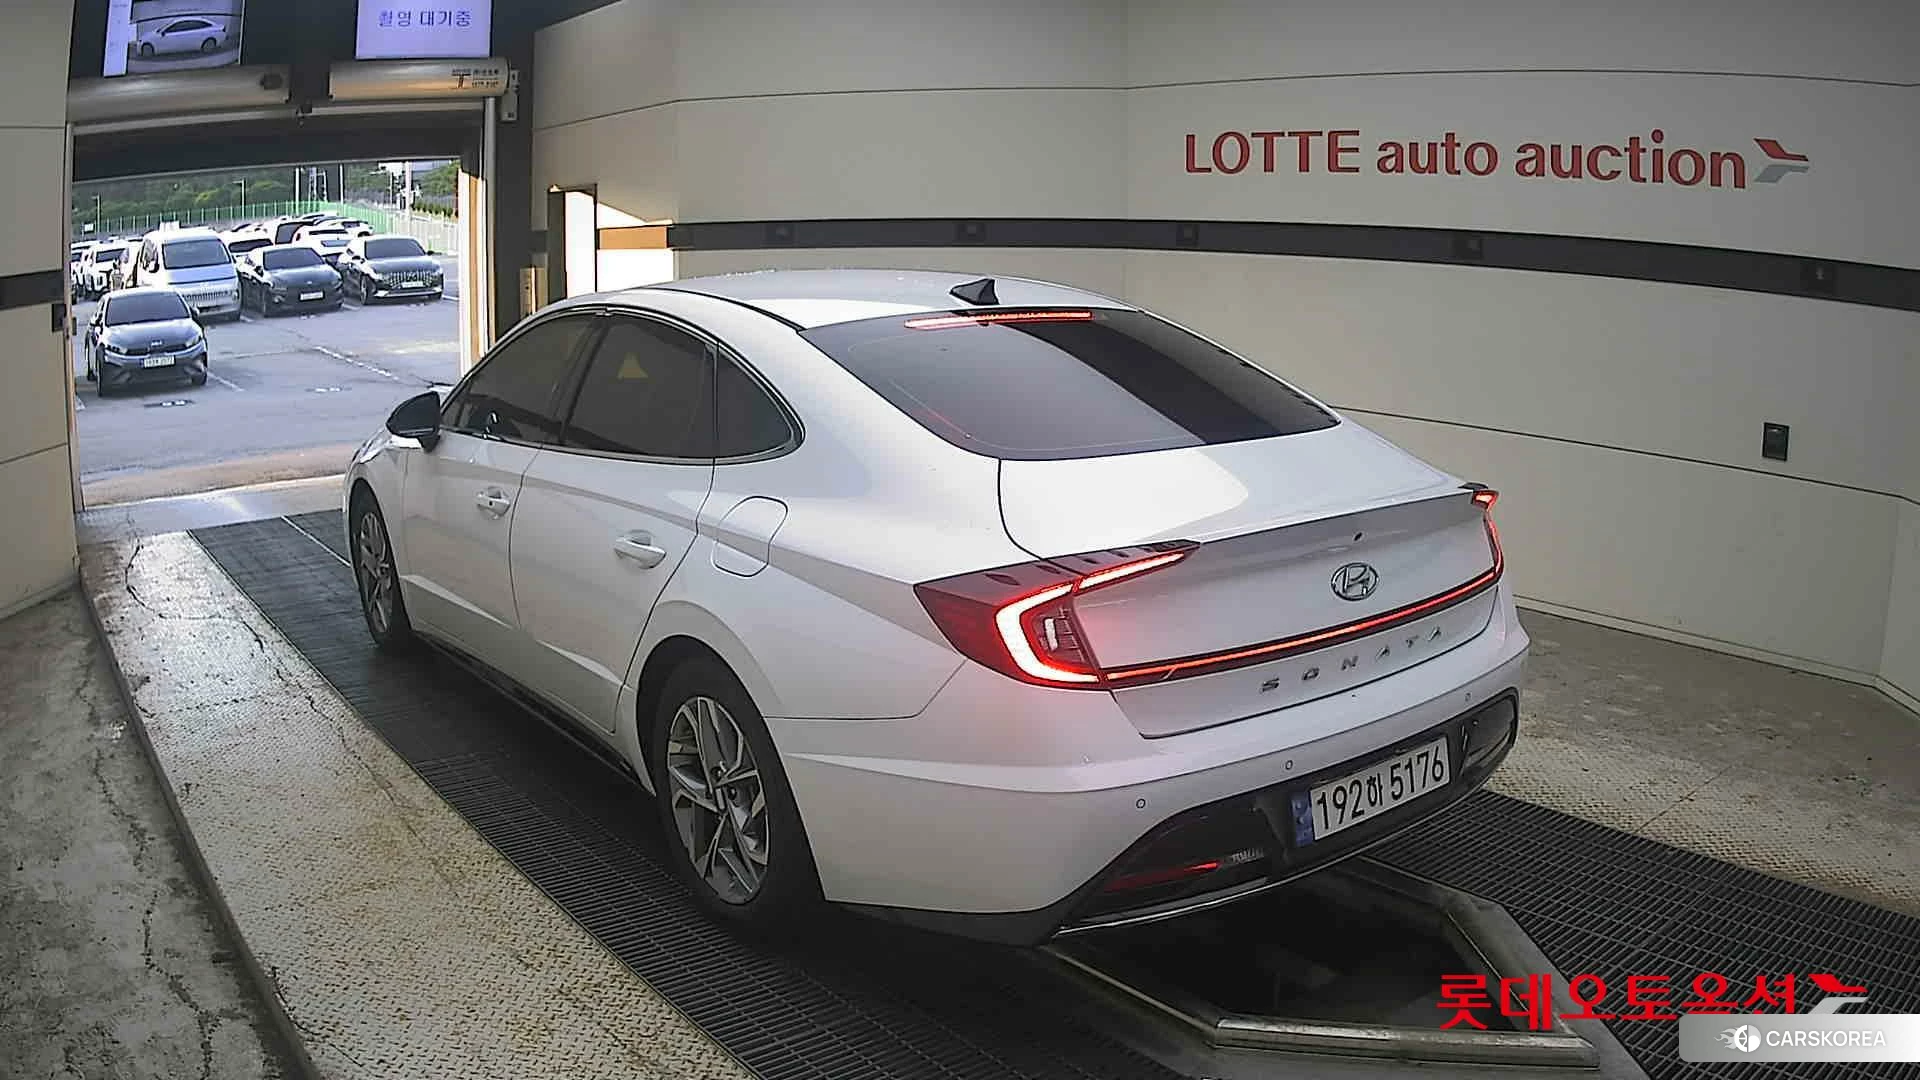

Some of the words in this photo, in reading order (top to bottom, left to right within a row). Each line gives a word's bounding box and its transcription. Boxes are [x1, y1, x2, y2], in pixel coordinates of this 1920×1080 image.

[420, 10, 472, 27] 대기중
[1184, 130, 1360, 174] LOTTE
[1376, 132, 1499, 176] auto
[1515, 129, 1746, 189] auction
[1261, 626, 1442, 693] SONATA
[1316, 772, 1384, 830] 192하
[1390, 745, 1445, 801] 5176
